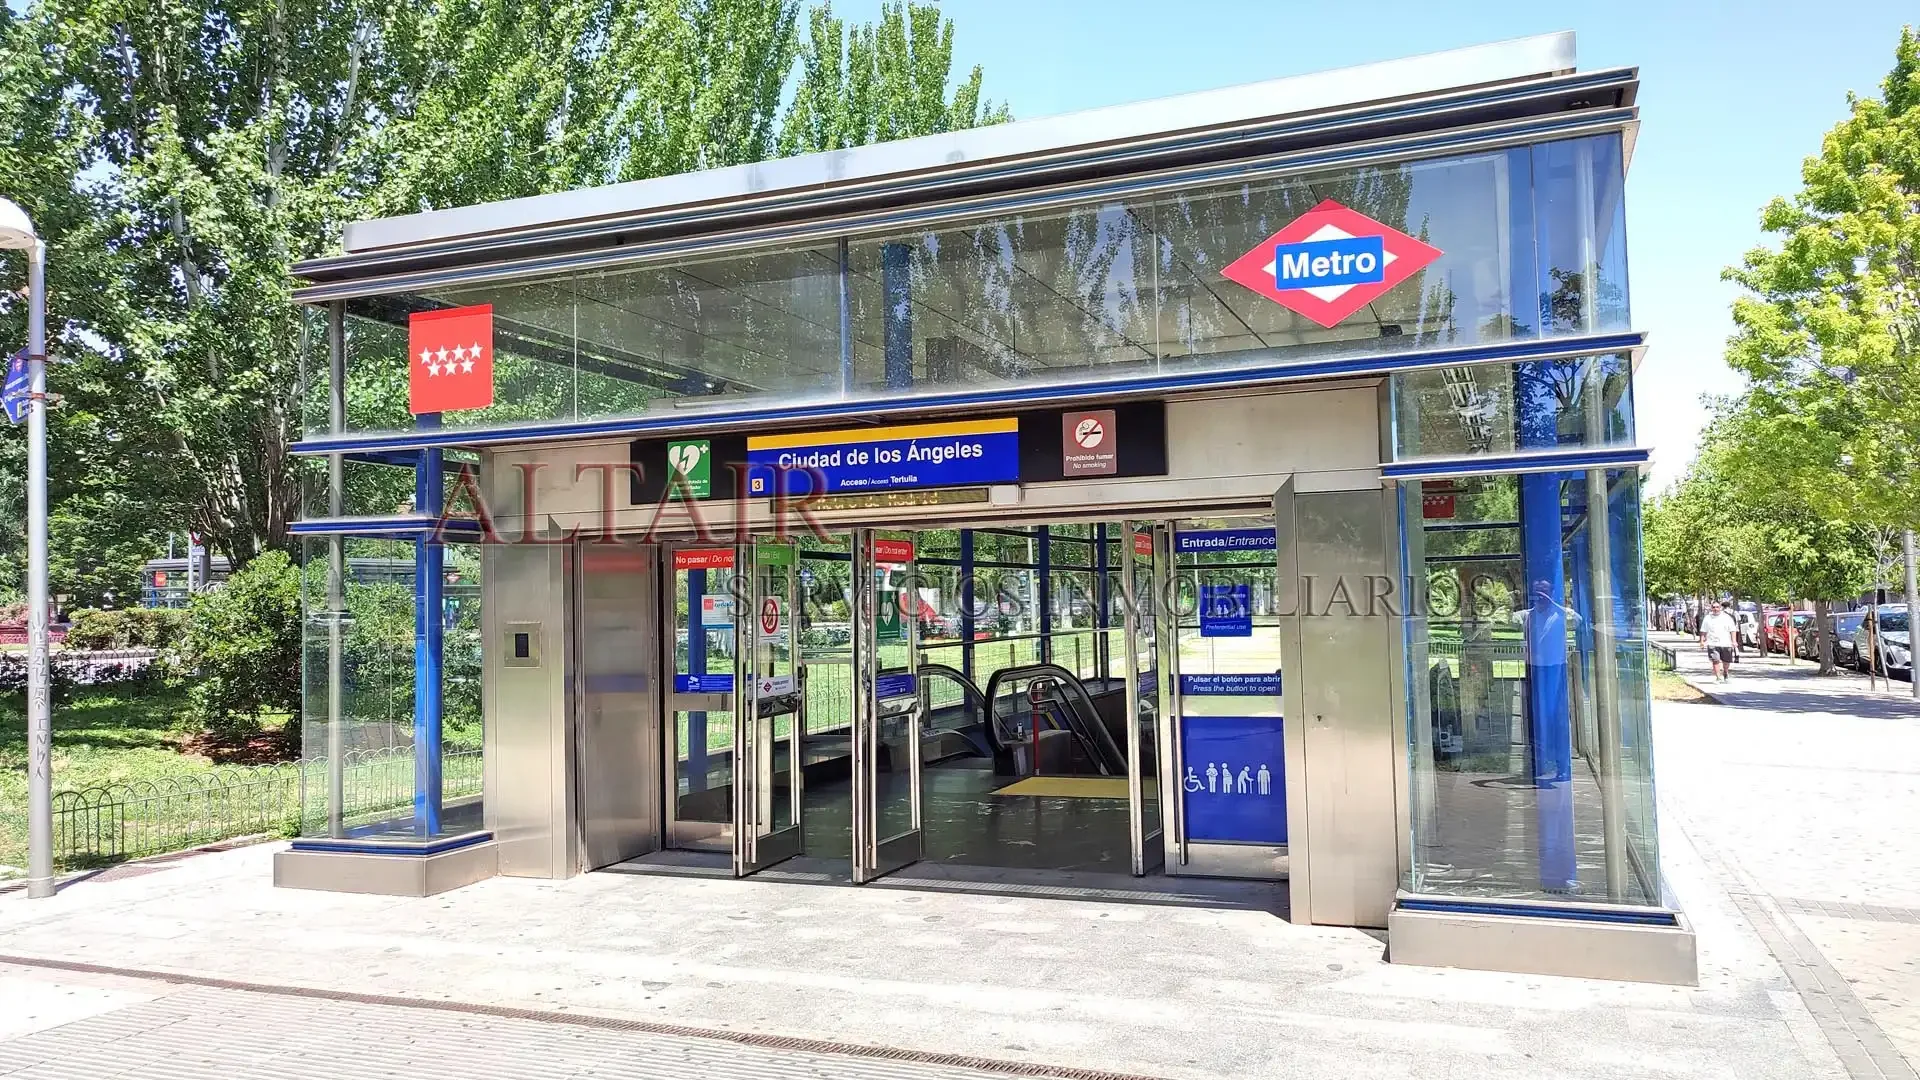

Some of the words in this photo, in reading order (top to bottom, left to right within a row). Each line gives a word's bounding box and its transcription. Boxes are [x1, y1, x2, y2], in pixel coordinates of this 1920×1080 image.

[1282, 250, 1376, 280] Metro
[778, 450, 841, 470] Ciudad
[846, 448, 869, 466] de
[874, 447, 902, 464] los
[906, 439, 983, 464] Ángeles
[1065, 454, 1095, 462] Prohibido
[889, 474, 918, 484] Tertulia
[754, 480, 761, 490] 3
[675, 556, 686, 565] No
[687, 556, 707, 566] pasar
[712, 554, 723, 563] Do
[1188, 675, 1211, 683] Pulsar
[1212, 675, 1220, 683] el
[1221, 675, 1243, 683] botón
